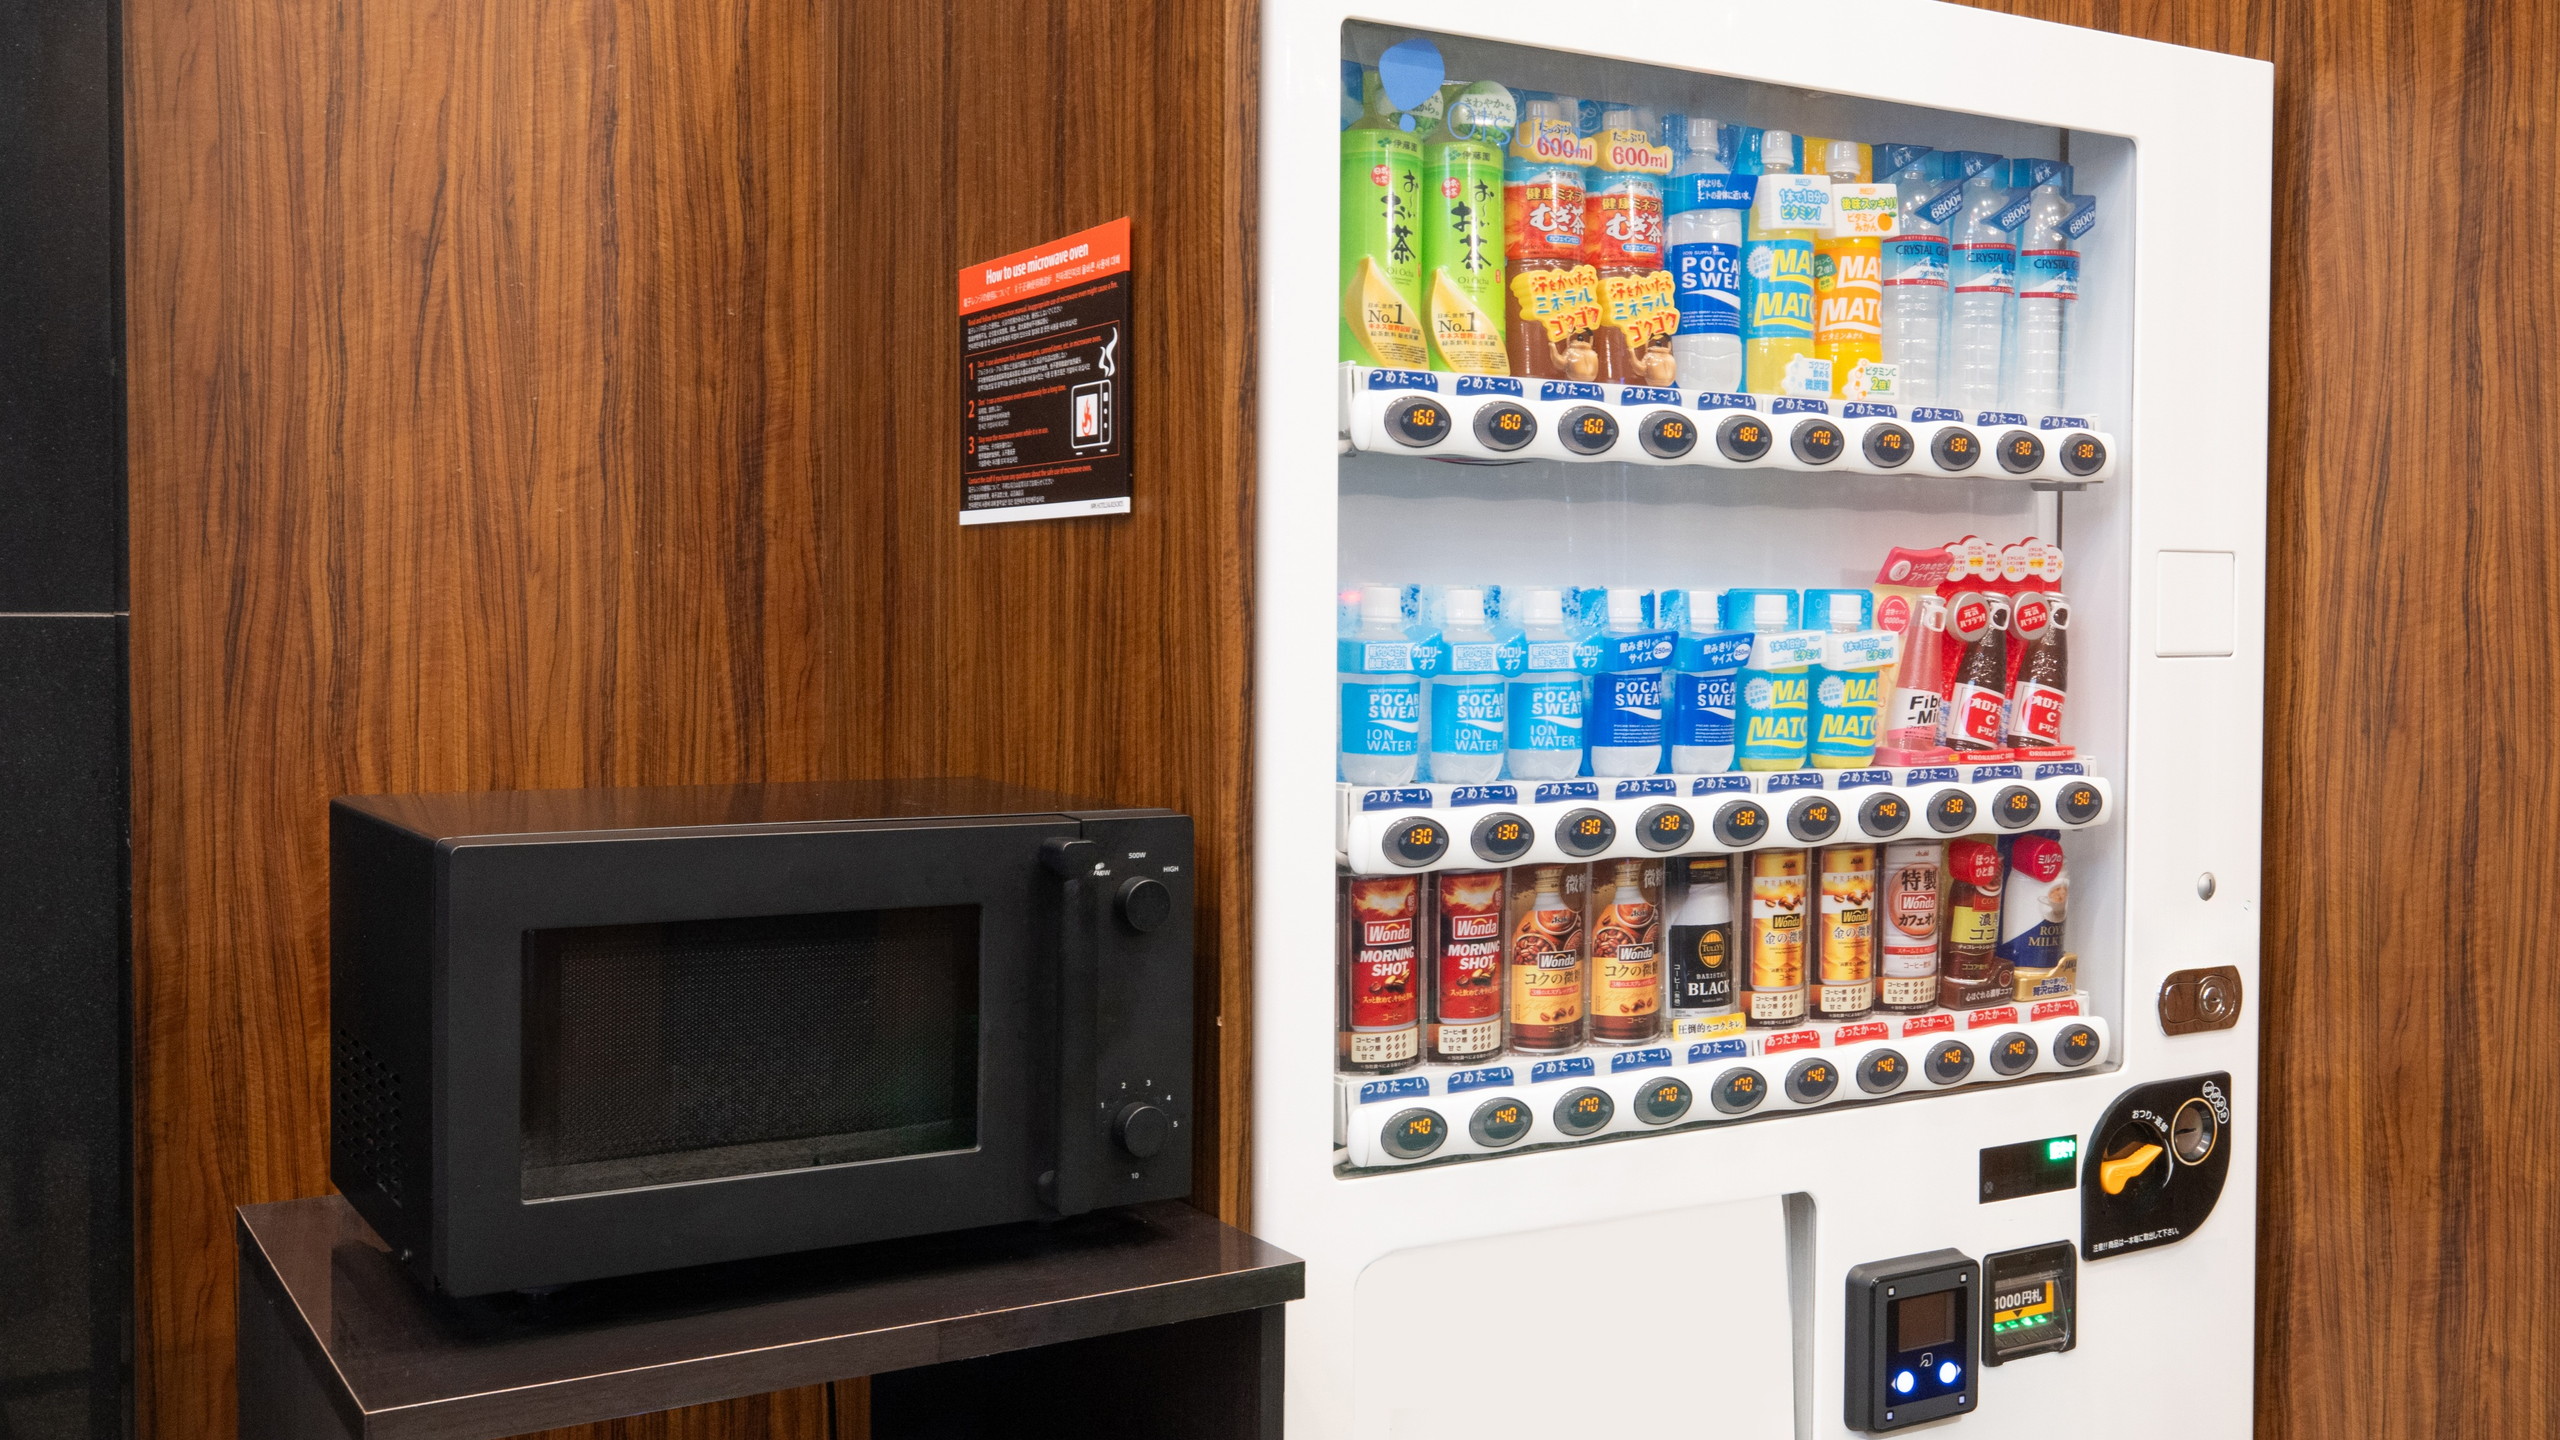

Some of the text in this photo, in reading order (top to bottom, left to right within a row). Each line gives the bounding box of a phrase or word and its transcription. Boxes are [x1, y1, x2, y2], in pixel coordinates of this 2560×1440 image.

[1612, 145, 1668, 169] 600ml
[1529, 202, 1586, 236] むぎ茶
[1847, 212, 1876, 223] ビタミン
[1854, 222, 1878, 232] みかん
[1895, 244, 1935, 256] CRYSTAL
[1968, 252, 2004, 264] CRYSTAL
[986, 242, 1089, 285] How to use microwave oven
[2034, 258, 2069, 270] CRYSTAL
[1533, 270, 1596, 294] 汗をかいたら
[1610, 275, 1673, 299] 汗をかいたら
[1536, 287, 1593, 315] ミネラル
[1615, 292, 1671, 321] ミネラル
[1368, 303, 1405, 325] No.1
[1439, 311, 1477, 333] No.1
[1550, 305, 1600, 337] ゴクゴク
[1628, 310, 1678, 343] ゴクゴク
[968, 363, 974, 380] 1
[968, 400, 975, 418] 2
[1412, 409, 1436, 427] 160
[1499, 414, 1522, 431] 160
[1583, 418, 1605, 435] 160
[1662, 423, 1684, 439] 160
[1738, 427, 1759, 443] 180
[968, 436, 975, 455] 3
[1950, 438, 1969, 453] 130
[2015, 441, 2033, 456] 130
[2077, 444, 2095, 459] 130
[1413, 644, 1443, 660] カロリー
[1498, 644, 1527, 660] カロリー
[1619, 639, 1651, 654] 飲みきり
[1418, 657, 1437, 671] オフ
[1504, 657, 1522, 671] オフ
[1628, 650, 1654, 664] サイズ
[2046, 713, 2057, 724] C
[1366, 729, 1394, 741] ION
[1455, 728, 1482, 741] ION
[1530, 724, 1558, 737] ION
[1366, 740, 1412, 752] WATER
[1455, 740, 1498, 752] WATER
[1530, 735, 1575, 748] WATER
[1946, 799, 1964, 814] 130
[2011, 795, 2029, 810] 150
[2073, 791, 2091, 806] 150
[1808, 807, 1828, 822] 140
[1878, 802, 1898, 817] 140
[1659, 815, 1681, 831] 130
[1735, 810, 1756, 827] 130
[1497, 824, 1520, 841] 130
[1580, 819, 1602, 836] 130
[1410, 828, 1433, 845] 130
[1975, 854, 1996, 866] ほっと
[2037, 853, 2063, 865] ミルクの
[1163, 865, 1179, 873] HIGH
[1901, 868, 1938, 891] 特製
[1902, 895, 1935, 909] Wonda
[1774, 915, 1800, 928] Wonda
[1842, 910, 1869, 923] Wonda
[1369, 924, 1410, 942] Wonda
[1457, 918, 1497, 937] Wonda
[1360, 946, 1415, 963] MORNING
[1447, 940, 1500, 957] MORNING
[1619, 945, 1653, 961] Wonda
[1371, 960, 1408, 977] SHOT
[1459, 955, 1495, 971] SHOT
[1540, 953, 1575, 969] Wonda
[1688, 979, 1730, 996] BLACK
[2008, 1041, 2026, 1055] 140
[2071, 1033, 2089, 1047] 140
[1943, 1049, 1962, 1064] 140
[1876, 1058, 1895, 1073] 140
[1146, 1079, 1151, 1087] 3
[1806, 1067, 1826, 1083] 140
[1495, 1107, 1518, 1124] 140
[1408, 1118, 1432, 1135] 140
[1994, 1288, 2043, 1311] 1000円札
